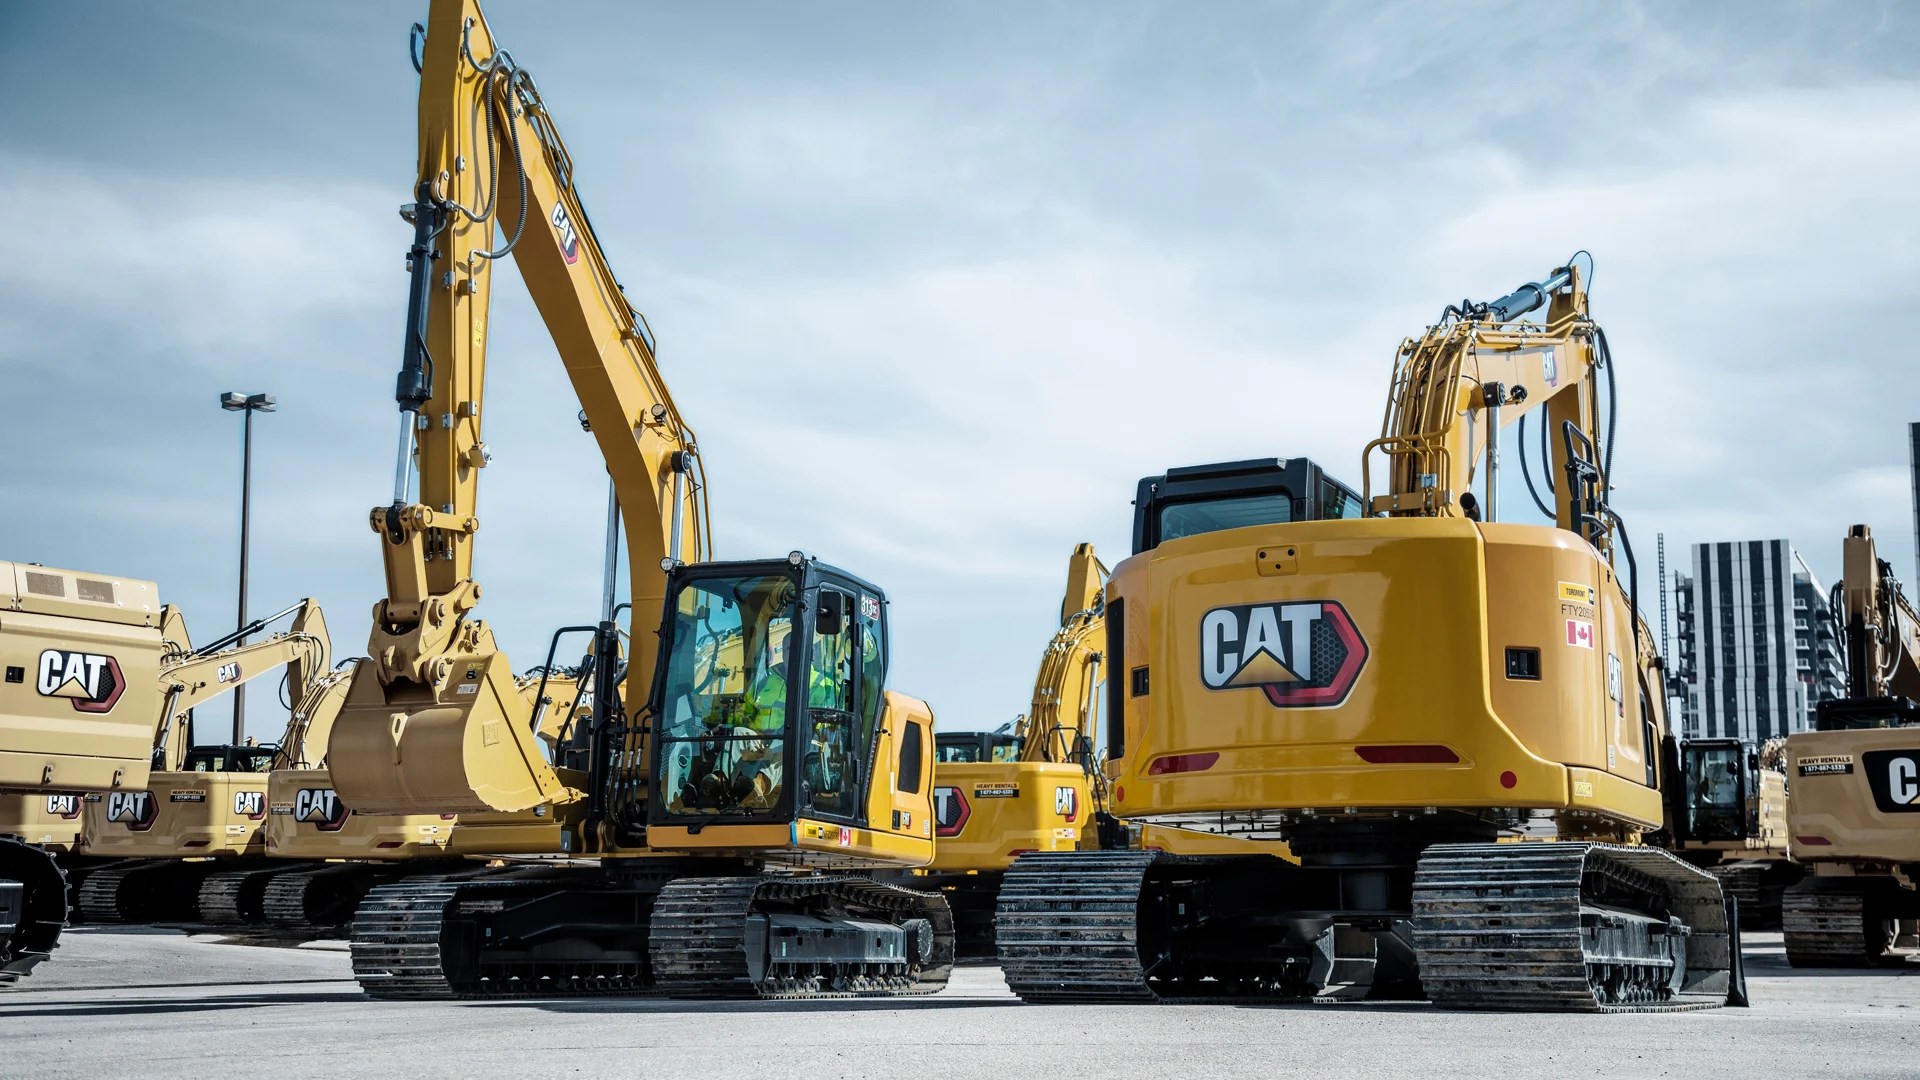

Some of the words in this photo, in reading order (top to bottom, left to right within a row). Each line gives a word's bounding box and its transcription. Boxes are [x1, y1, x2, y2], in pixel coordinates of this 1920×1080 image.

[552, 202, 576, 251] CAT
[861, 594, 873, 616] 313
[1202, 603, 1321, 687] CAT
[38, 650, 107, 699] CAT
[217, 662, 236, 683] CAT
[1608, 653, 1622, 703] CAT
[1889, 757, 1920, 805] C
[47, 795, 76, 813] CAT
[108, 791, 148, 821] CAT
[235, 791, 262, 814] CAT
[296, 789, 338, 821] CAT
[934, 787, 952, 825] T
[1055, 787, 1074, 815] CAT
